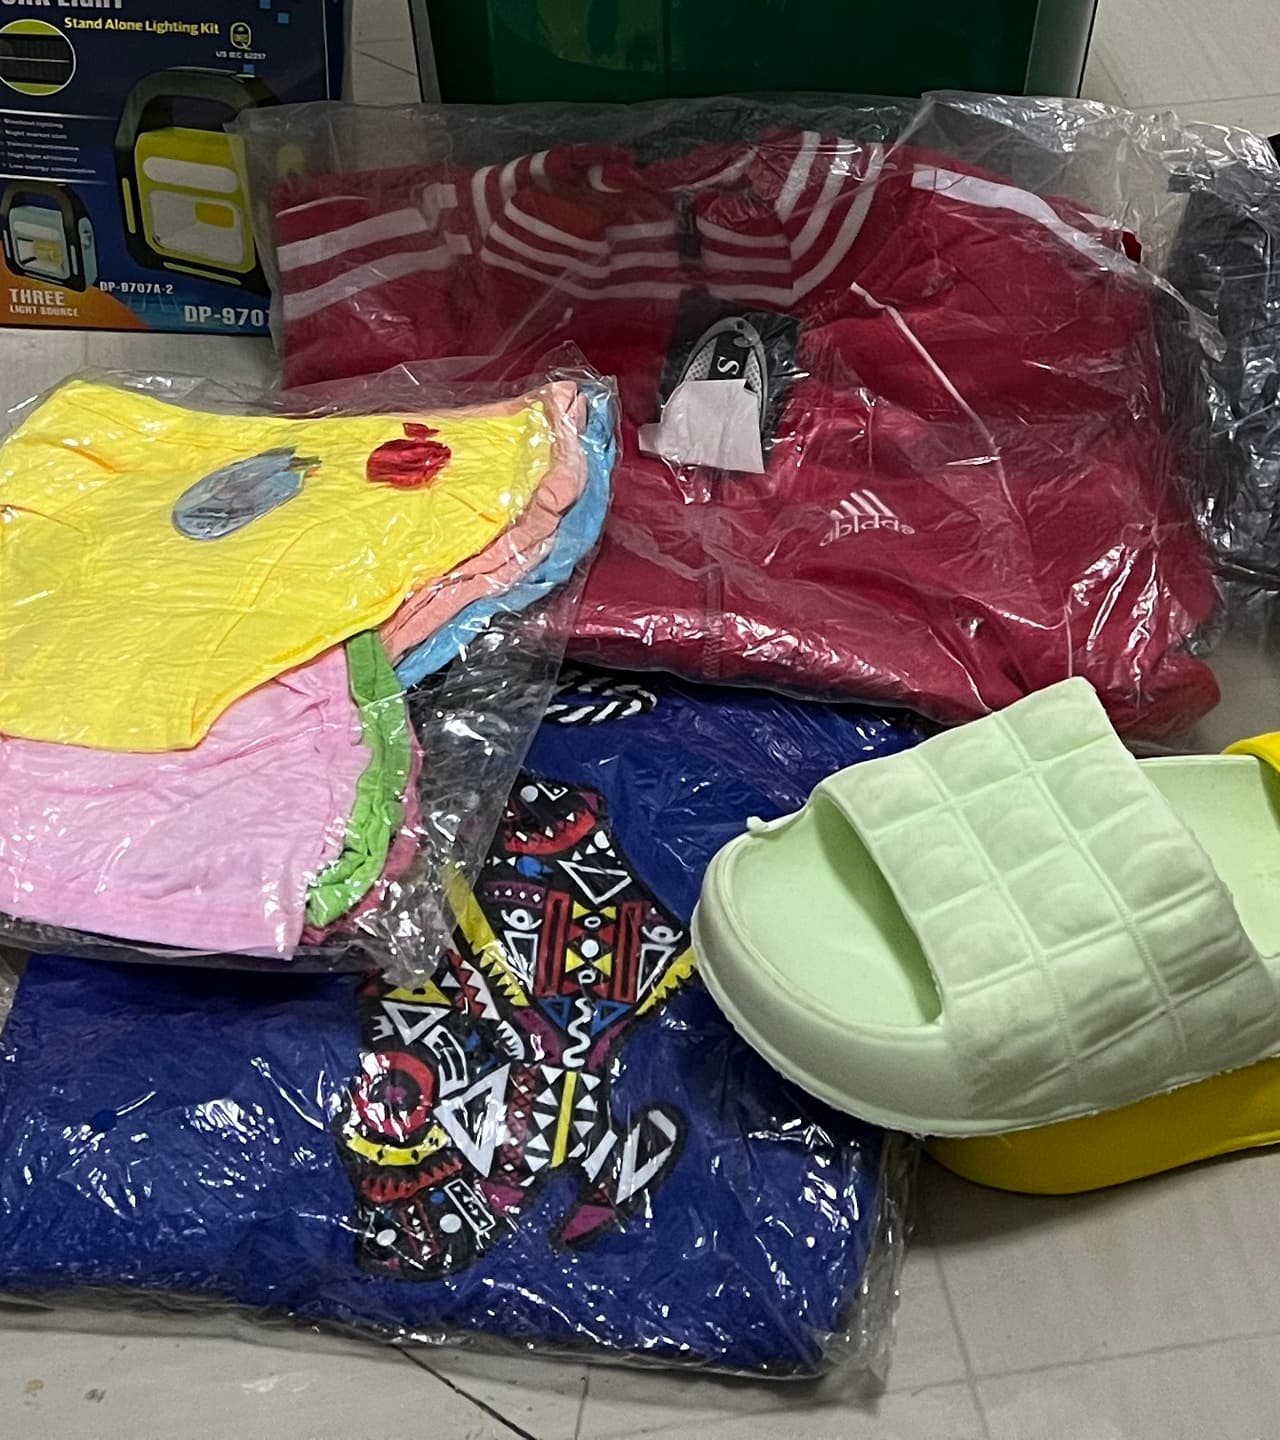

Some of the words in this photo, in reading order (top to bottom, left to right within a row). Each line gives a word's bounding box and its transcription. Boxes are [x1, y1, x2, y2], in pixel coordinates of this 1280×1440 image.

[64, 16, 102, 30] Stand
[104, 18, 143, 31] Alone
[145, 20, 199, 36] Lighting
[200, 22, 220, 35] Kit
[8, 288, 65, 306] THREE
[9, 305, 38, 316] LIGHT
